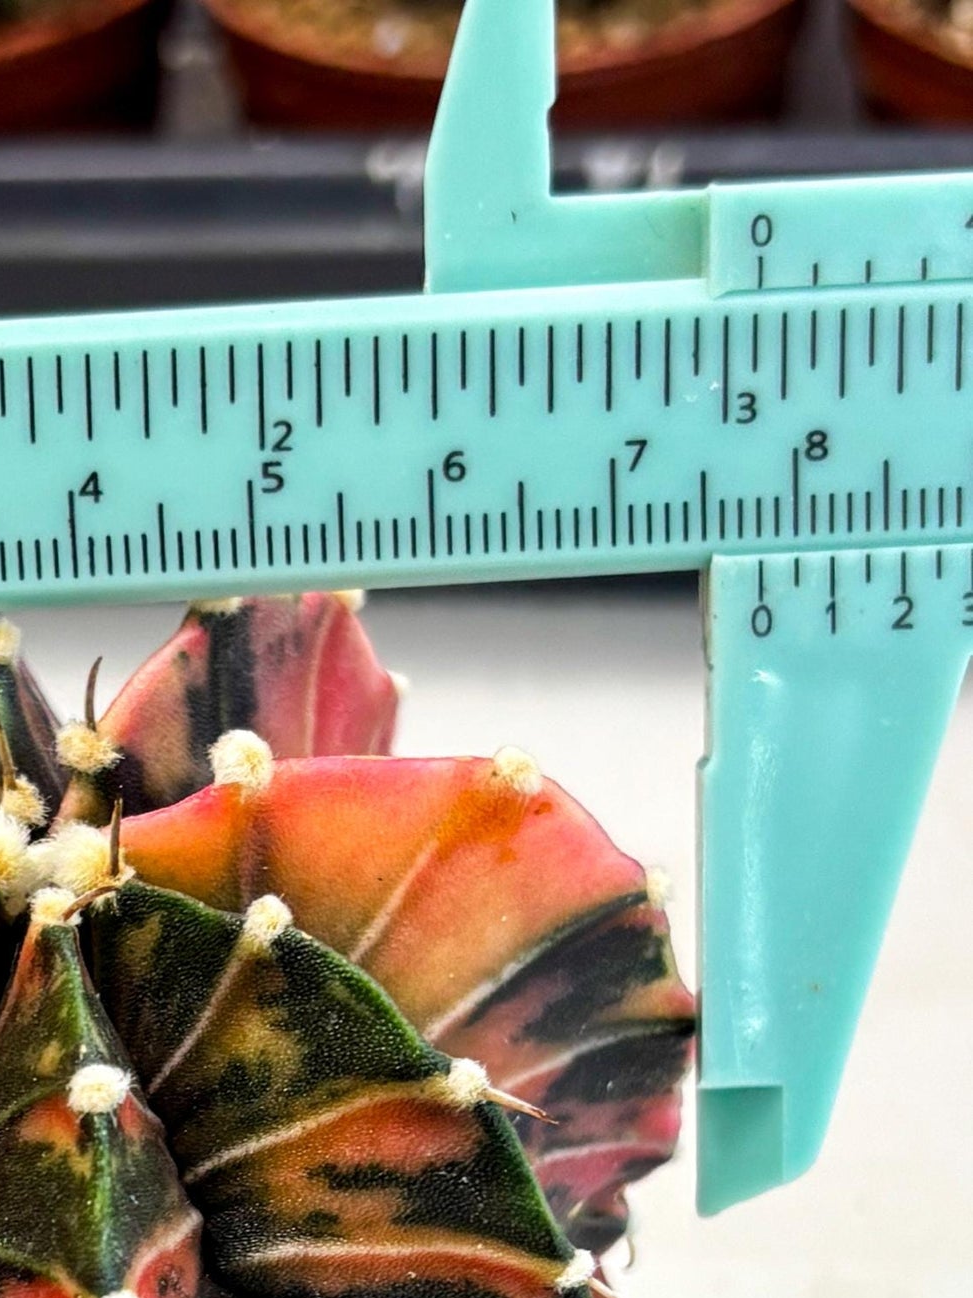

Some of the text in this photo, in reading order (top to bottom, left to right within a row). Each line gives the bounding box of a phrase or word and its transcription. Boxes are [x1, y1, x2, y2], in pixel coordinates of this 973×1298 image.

[751, 214, 772, 247] 0
[272, 421, 292, 452] 2
[737, 392, 757, 424] 3
[79, 472, 103, 503] 4
[262, 461, 284, 493] 5
[443, 451, 466, 482] 6
[625, 439, 647, 471] 7
[805, 430, 828, 461] 8
[751, 604, 772, 637] 0
[826, 601, 836, 634] 1
[892, 595, 913, 629] 2
